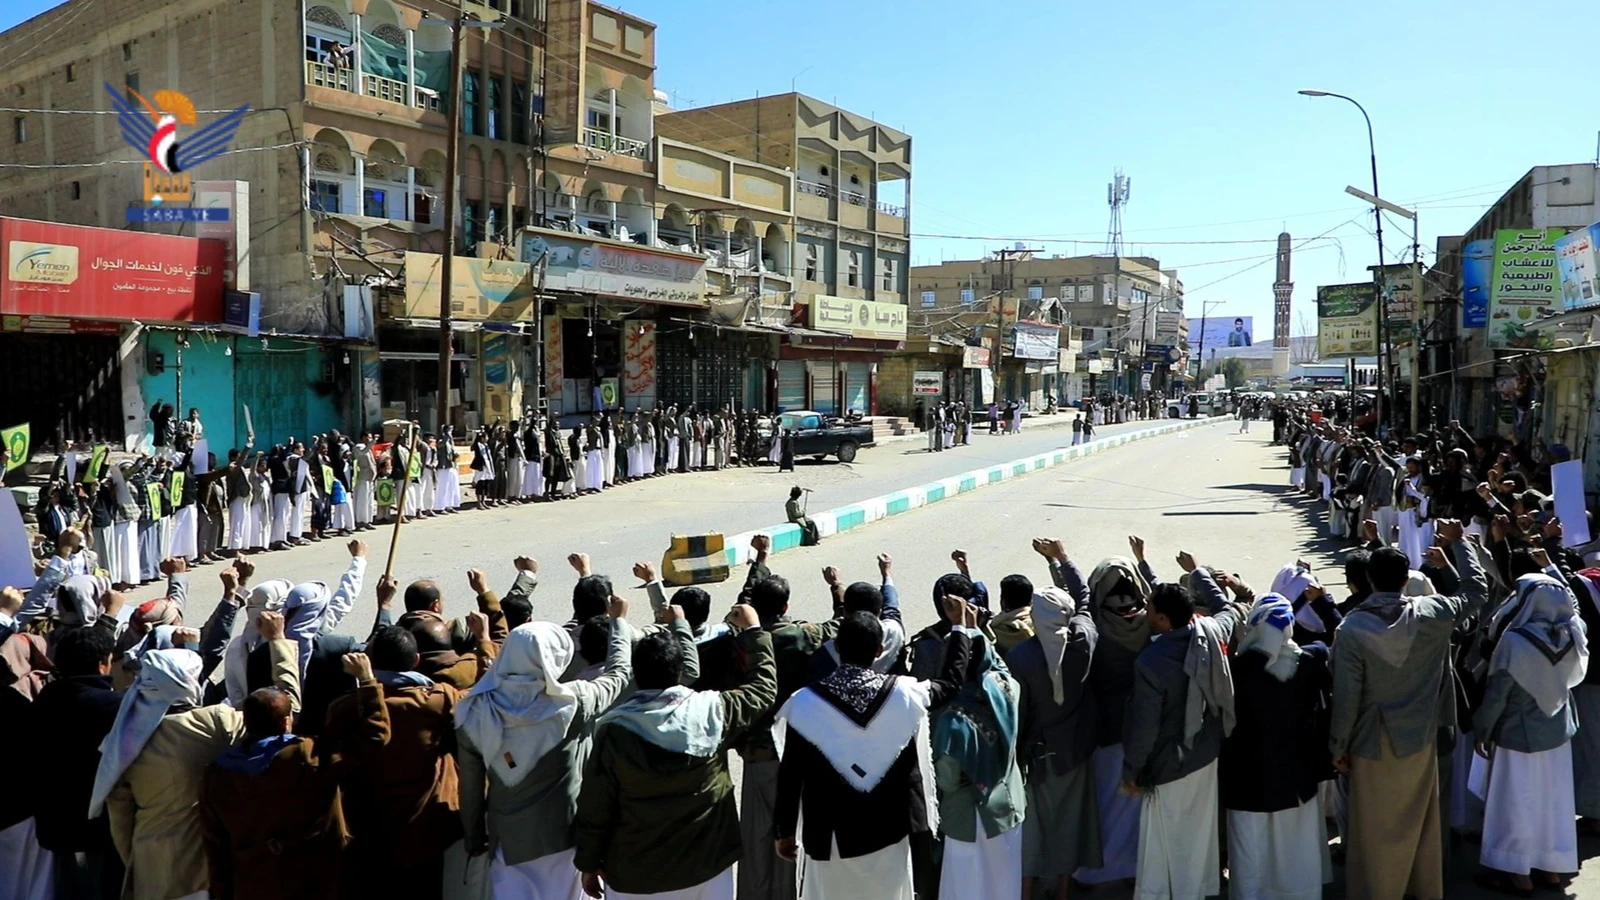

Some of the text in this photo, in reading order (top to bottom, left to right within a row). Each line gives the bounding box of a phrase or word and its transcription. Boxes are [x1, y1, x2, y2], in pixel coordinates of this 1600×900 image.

[1517, 230, 1546, 241] أبو
[29, 258, 70, 271] Yemen
[91, 257, 123, 271] الجوال
[125, 260, 162, 272] لخدمات
[164, 263, 183, 275] فون
[1501, 271, 1553, 281] الطبيعية
[1498, 282, 1553, 293] والبخور
